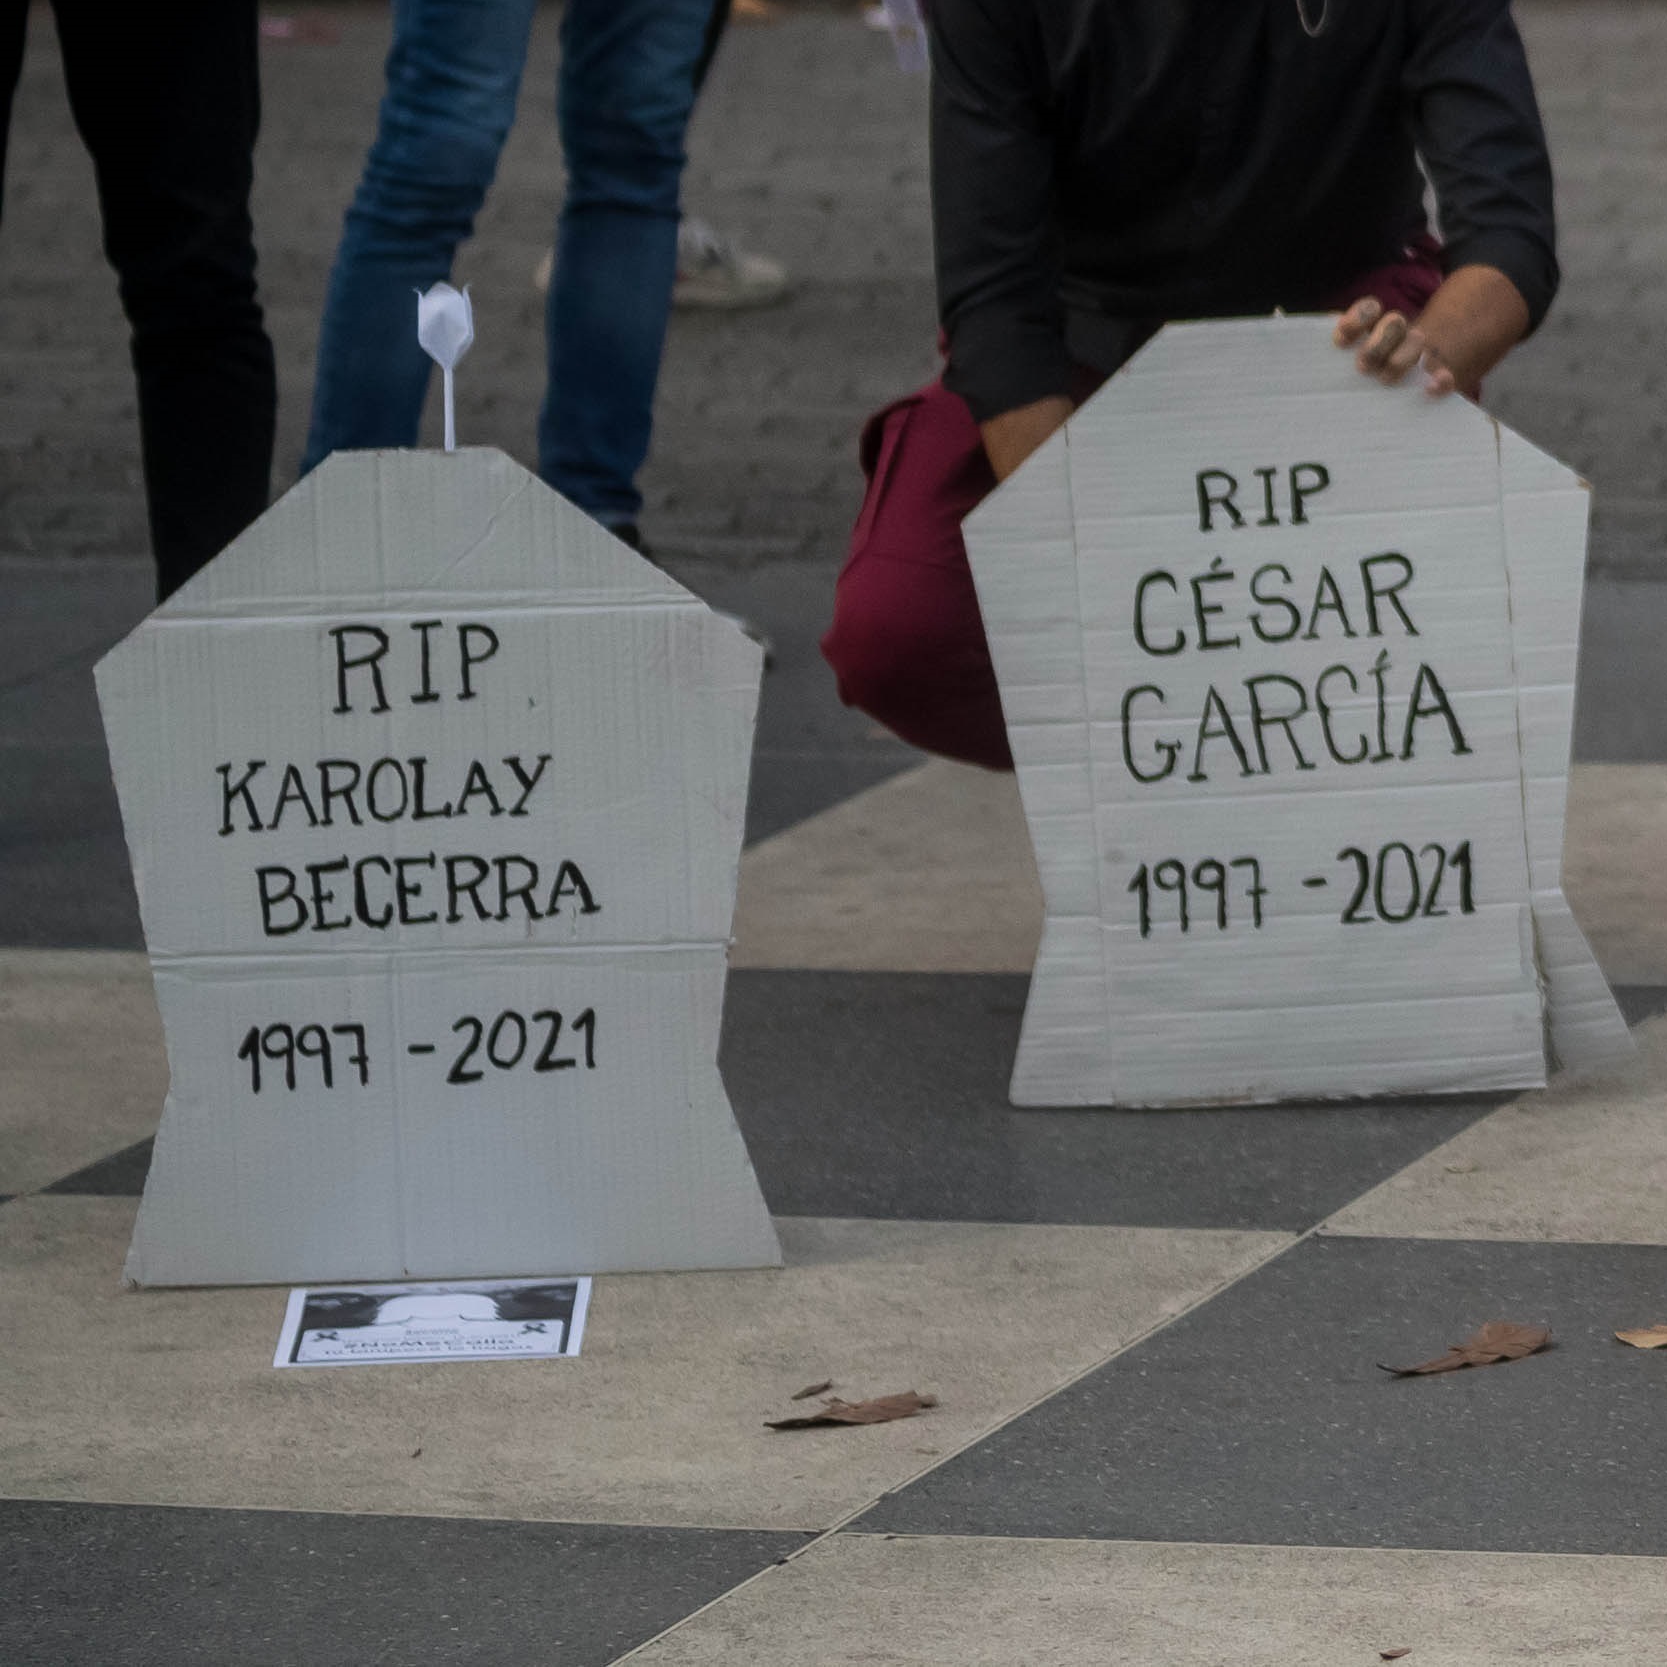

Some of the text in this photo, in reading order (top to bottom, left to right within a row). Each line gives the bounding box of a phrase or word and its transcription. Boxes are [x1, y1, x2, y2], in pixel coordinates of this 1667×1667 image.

[1197, 463, 1330, 532] RIP
[1134, 553, 1419, 656] CÉSAR
[329, 620, 499, 714] RIP
[1121, 650, 1472, 783] GARCÍA
[216, 754, 552, 836] KAROLAY
[256, 852, 601, 936] BECERRA
[1129, 858, 1267, 938] 1997
[238, 1023, 368, 1094] 1997
